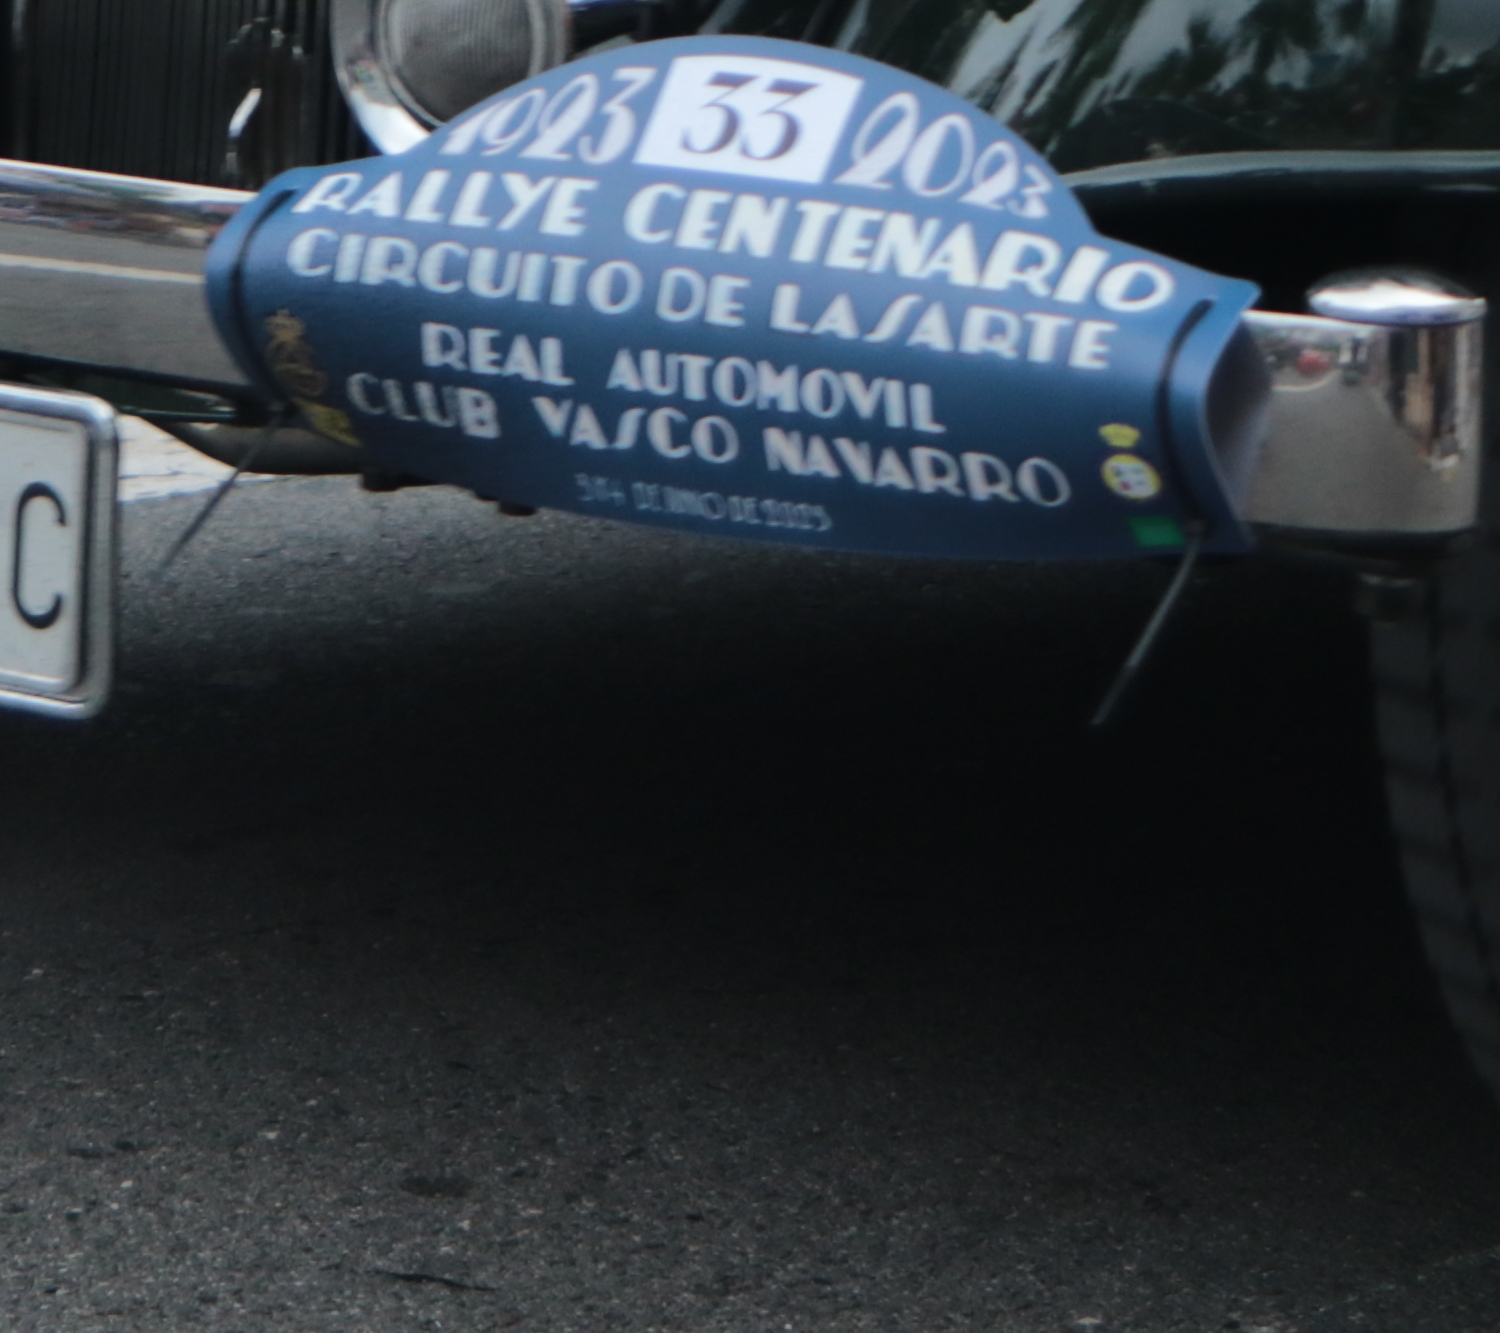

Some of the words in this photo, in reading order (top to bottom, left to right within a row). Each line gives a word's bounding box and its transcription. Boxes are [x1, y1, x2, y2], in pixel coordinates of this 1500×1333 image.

[438, 66, 658, 165] 1923
[680, 70, 819, 161] 33
[834, 91, 1053, 219] 2023
[286, 227, 644, 316] CIRCUITO
[655, 265, 751, 329] DE
[768, 283, 1118, 371] LASARTE
[291, 169, 600, 237] RALLYE
[623, 182, 1176, 314] CENTENARIO
[346, 371, 500, 439] CLUB
[531, 395, 740, 464] VASCO
[761, 427, 1073, 509] NAVARRO
[420, 321, 576, 387] REAL
[606, 348, 948, 434] AUTOMOVIL
